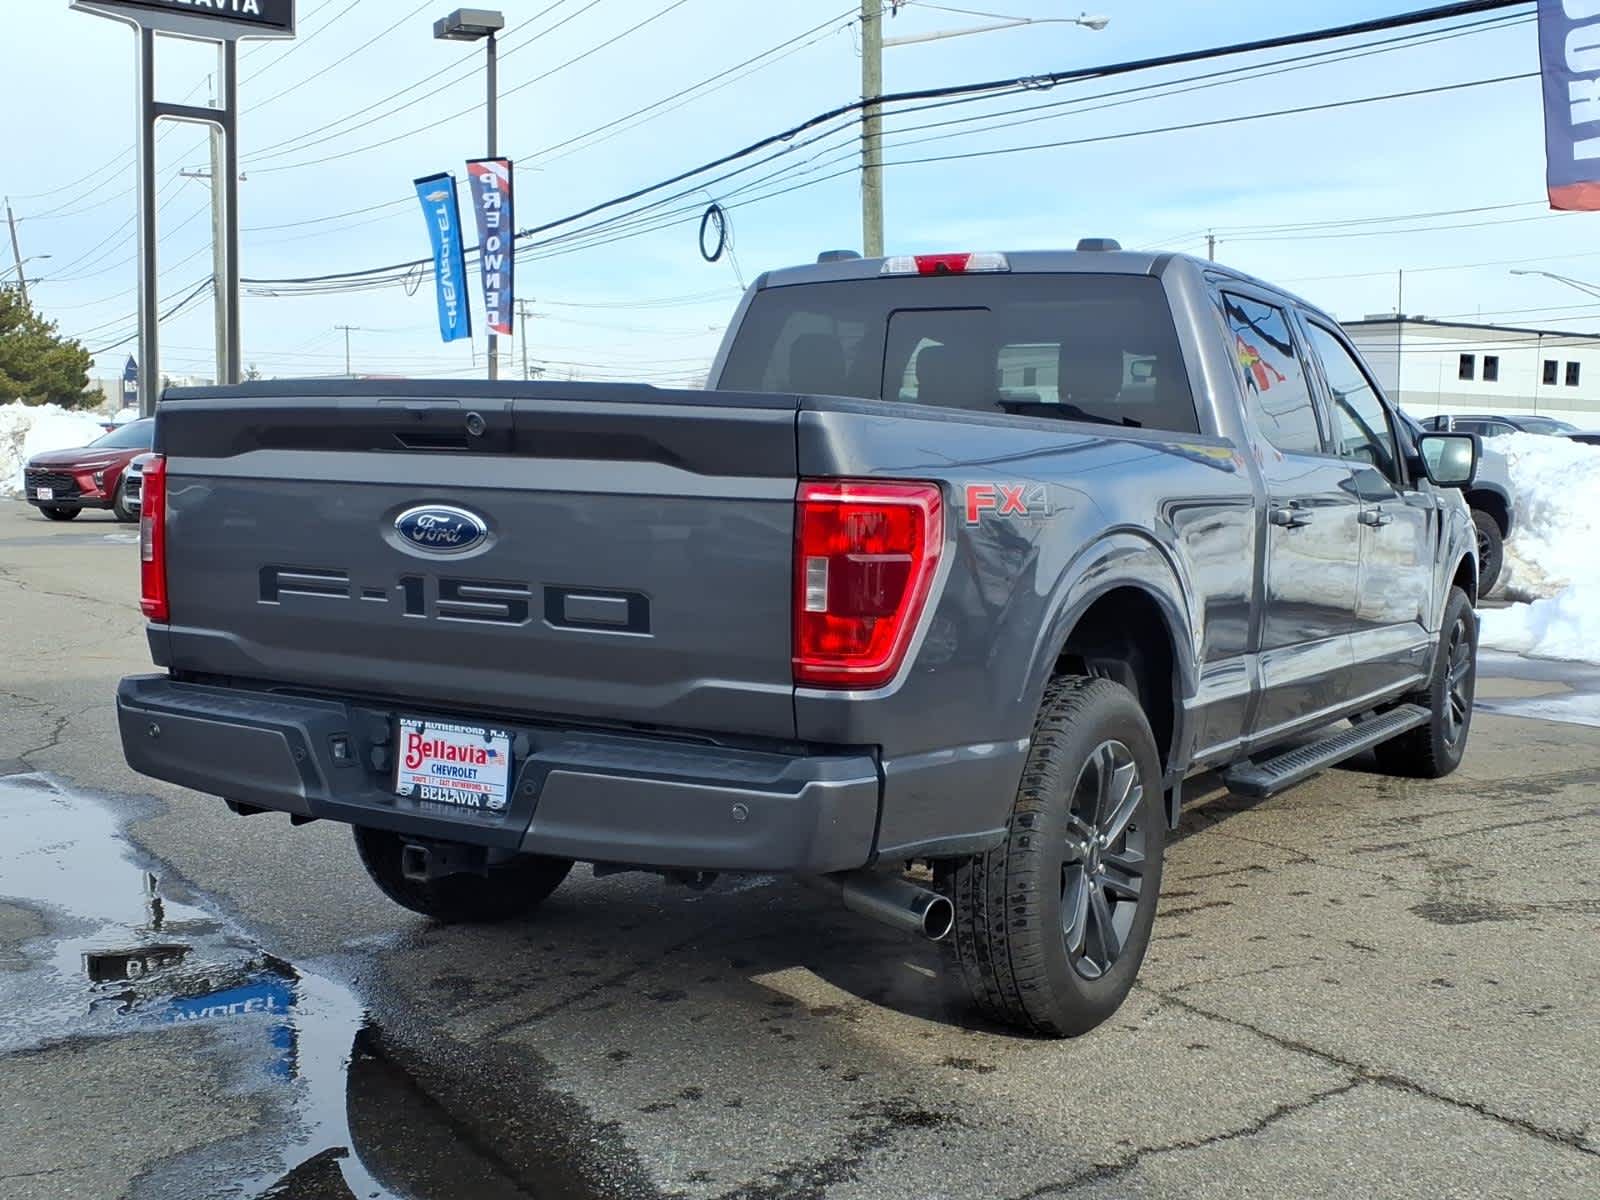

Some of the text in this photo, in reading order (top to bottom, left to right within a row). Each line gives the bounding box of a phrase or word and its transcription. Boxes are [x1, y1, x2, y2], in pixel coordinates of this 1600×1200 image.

[964, 482, 1057, 528] FX4
[413, 514, 463, 543] Ford
[257, 565, 655, 638] F-150
[400, 719, 423, 728] EAST
[425, 722, 485, 735] RUTHERFORD
[405, 733, 487, 769] Bellavia
[431, 763, 477, 779] CHEVROLET
[420, 786, 480, 807] BELLAVIA
